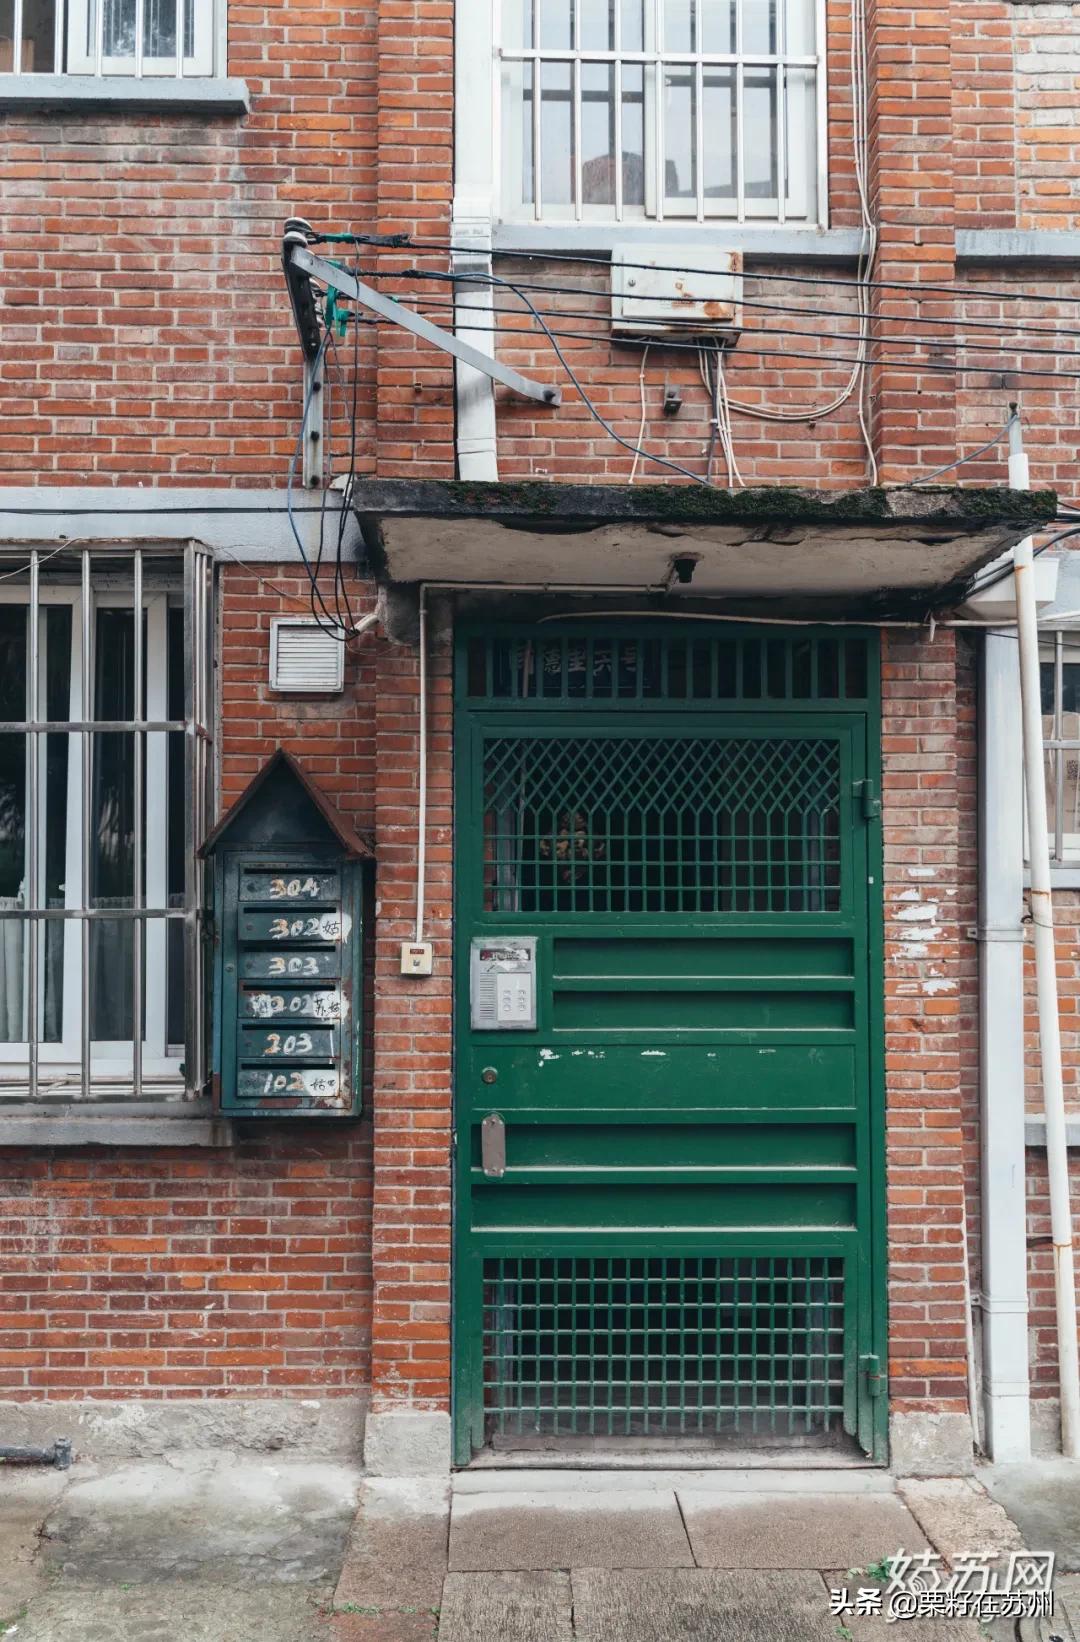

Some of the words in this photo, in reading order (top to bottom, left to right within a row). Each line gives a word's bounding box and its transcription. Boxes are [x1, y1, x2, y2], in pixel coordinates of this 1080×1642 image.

[269, 877, 321, 899] 304
[268, 917, 321, 940] 302
[268, 956, 320, 975] 303
[263, 1033, 313, 1055] 203
[263, 1071, 304, 1094] 102
